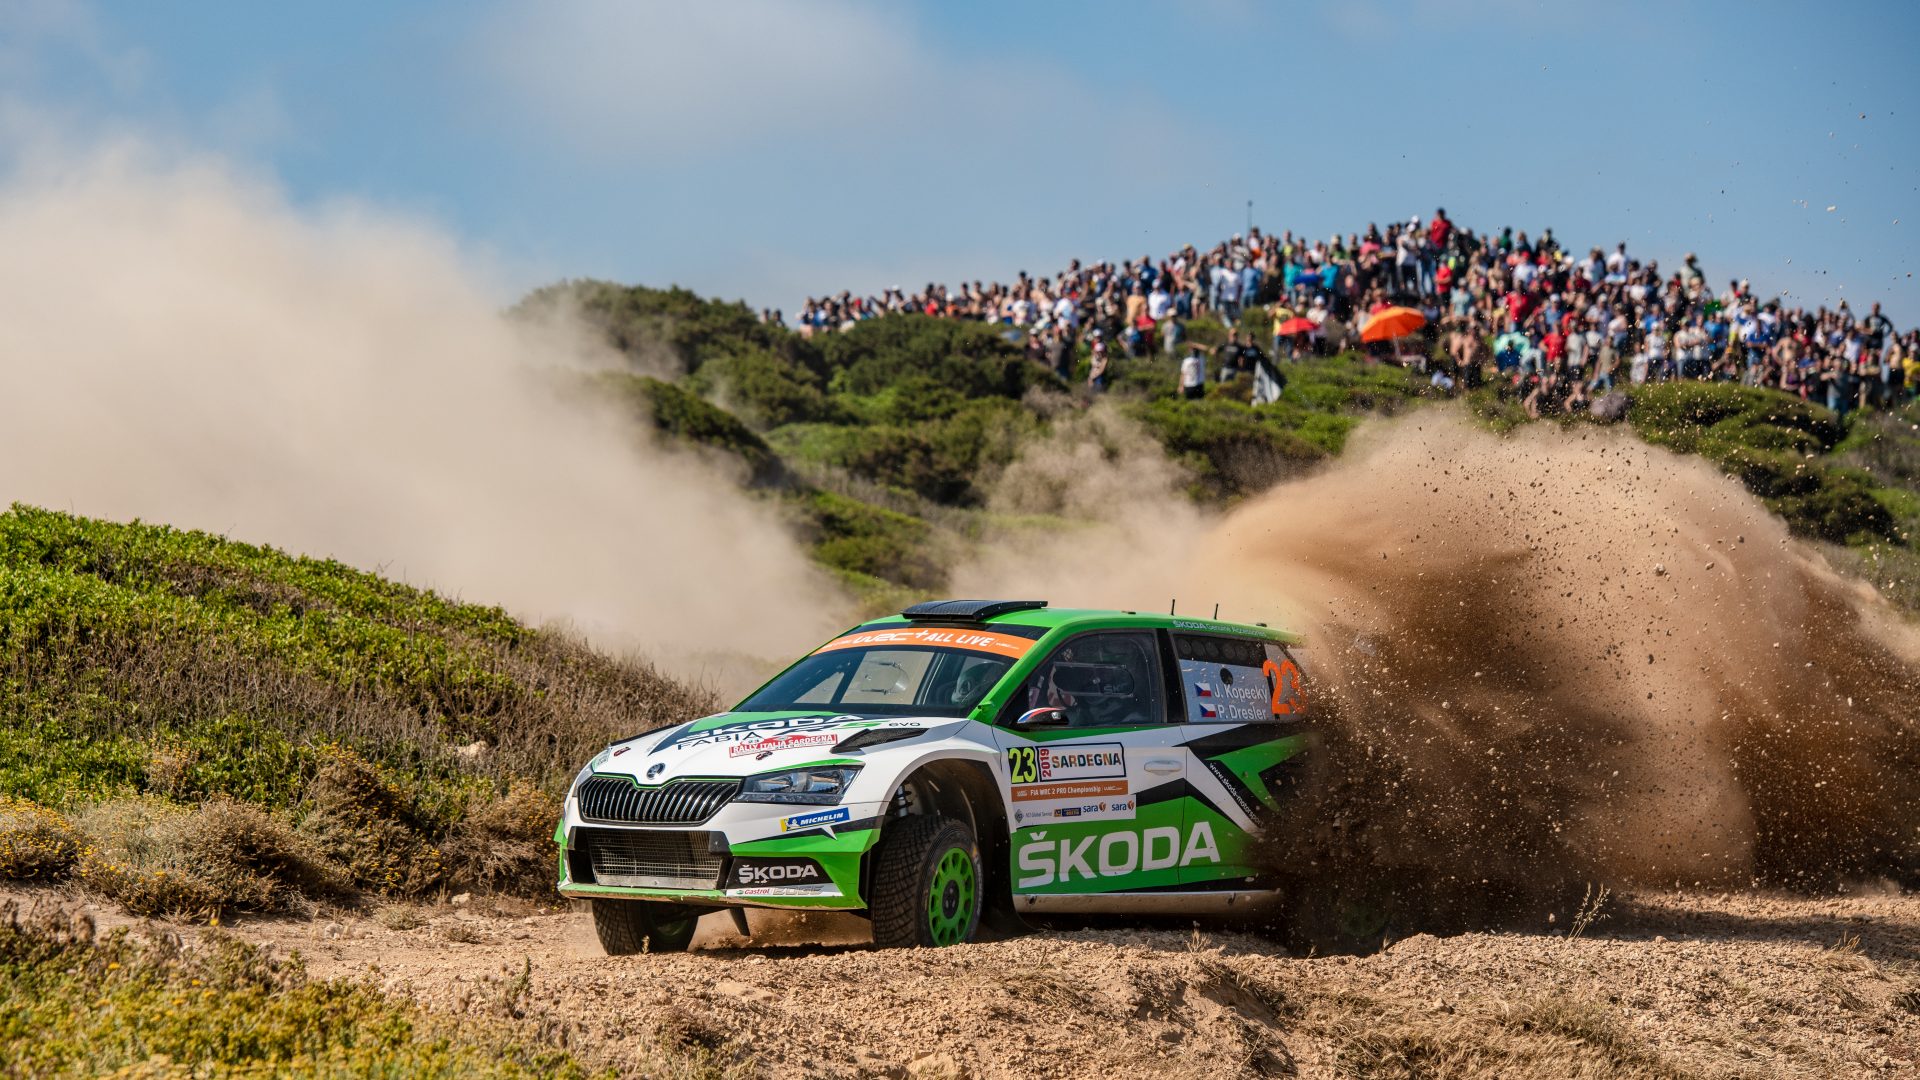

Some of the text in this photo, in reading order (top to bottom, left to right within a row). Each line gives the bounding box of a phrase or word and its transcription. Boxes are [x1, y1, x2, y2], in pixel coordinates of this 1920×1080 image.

[923, 632, 955, 644] ALL
[956, 634, 994, 648] LIVE
[1214, 683, 1224, 699] J.
[1262, 658, 1307, 715] 23
[1217, 704, 1229, 719] P.
[677, 731, 763, 751] FABIA
[733, 743, 759, 754] RALLY
[760, 740, 787, 751] ITALIA
[788, 734, 833, 746] SARDEGNA
[1008, 747, 1037, 784] 23
[1040, 748, 1052, 778] 2019
[1052, 752, 1122, 769] SARDEGNA
[1030, 788, 1039, 796] FIA
[1051, 787, 1056, 795] 2
[1056, 787, 1067, 795] PRO
[1068, 784, 1101, 794] Championship
[1083, 804, 1099, 813] sara
[1111, 802, 1127, 812] sara
[800, 812, 844, 826] MICHELIN
[1018, 821, 1221, 889] ŠKODA
[738, 864, 819, 884] ŠKODA
[744, 887, 770, 896] Castrol
